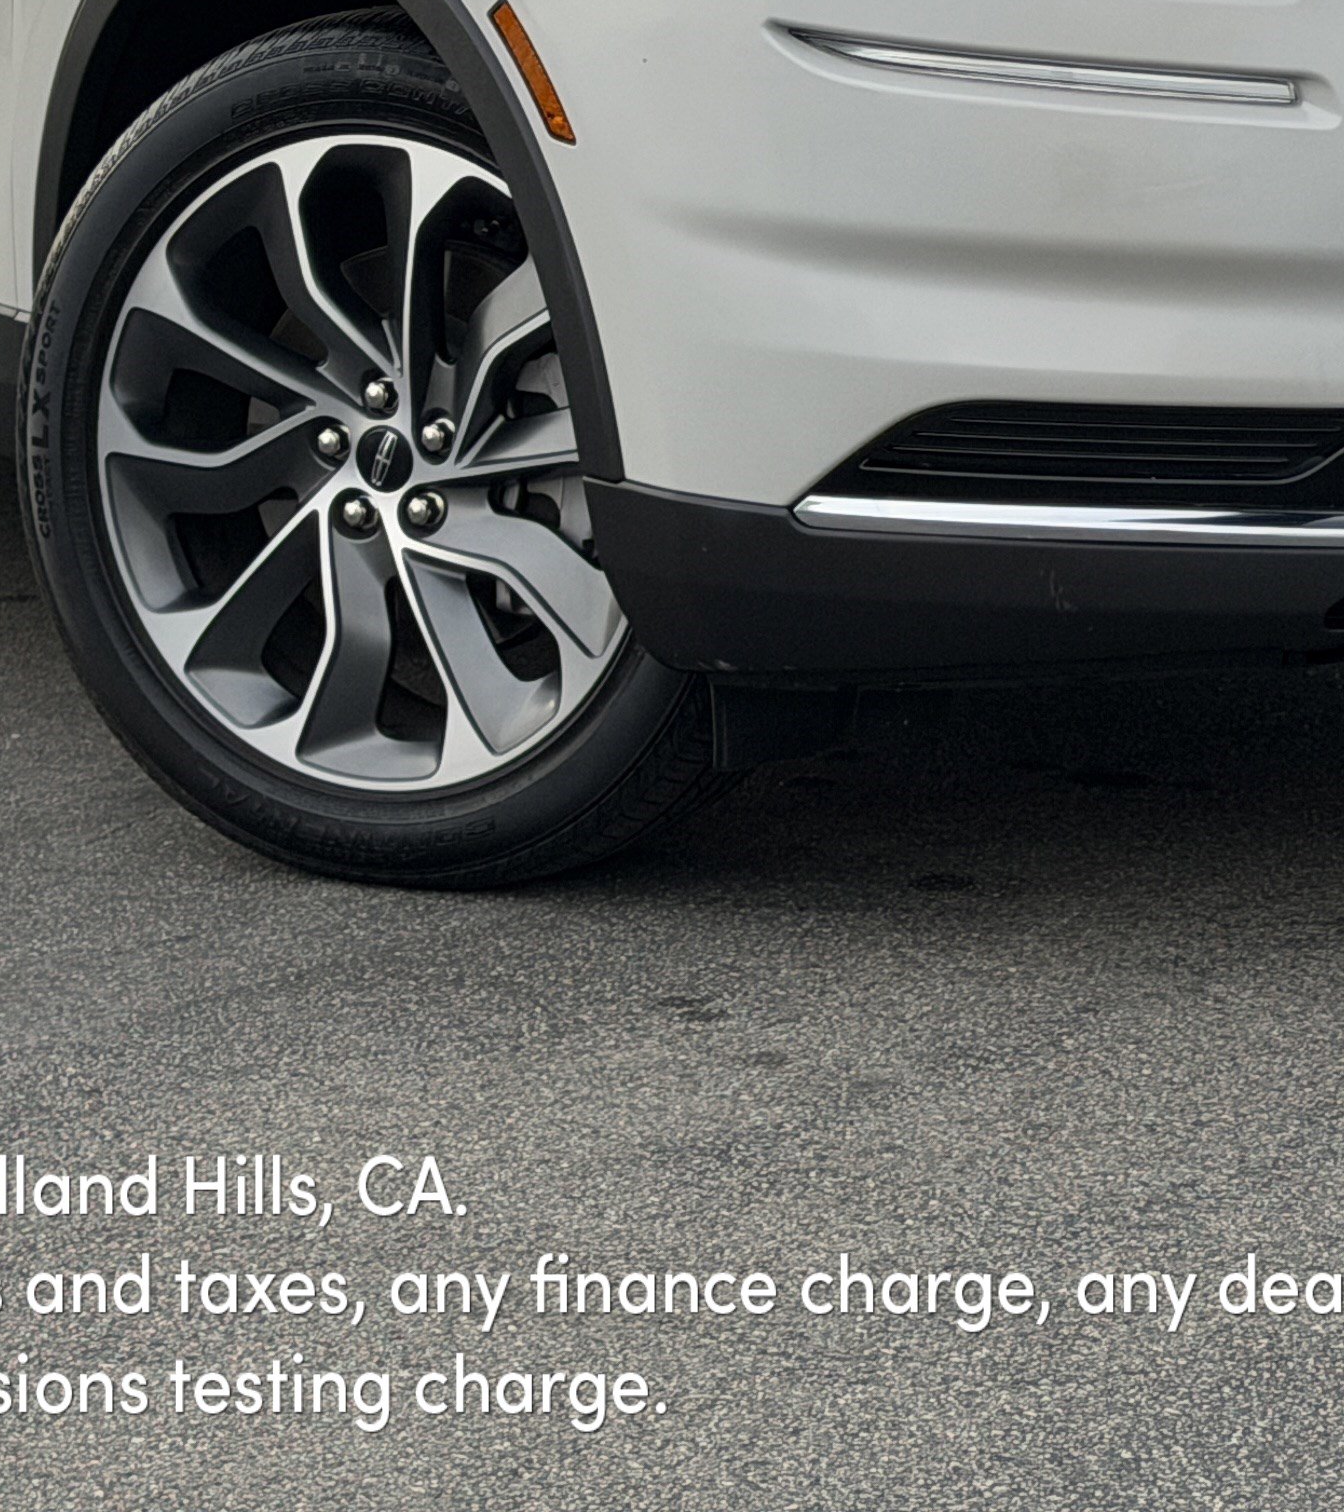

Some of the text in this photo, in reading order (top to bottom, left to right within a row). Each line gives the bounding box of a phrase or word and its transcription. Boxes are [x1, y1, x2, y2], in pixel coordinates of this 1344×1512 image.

[31, 299, 61, 539] CROSS LX SPORT
